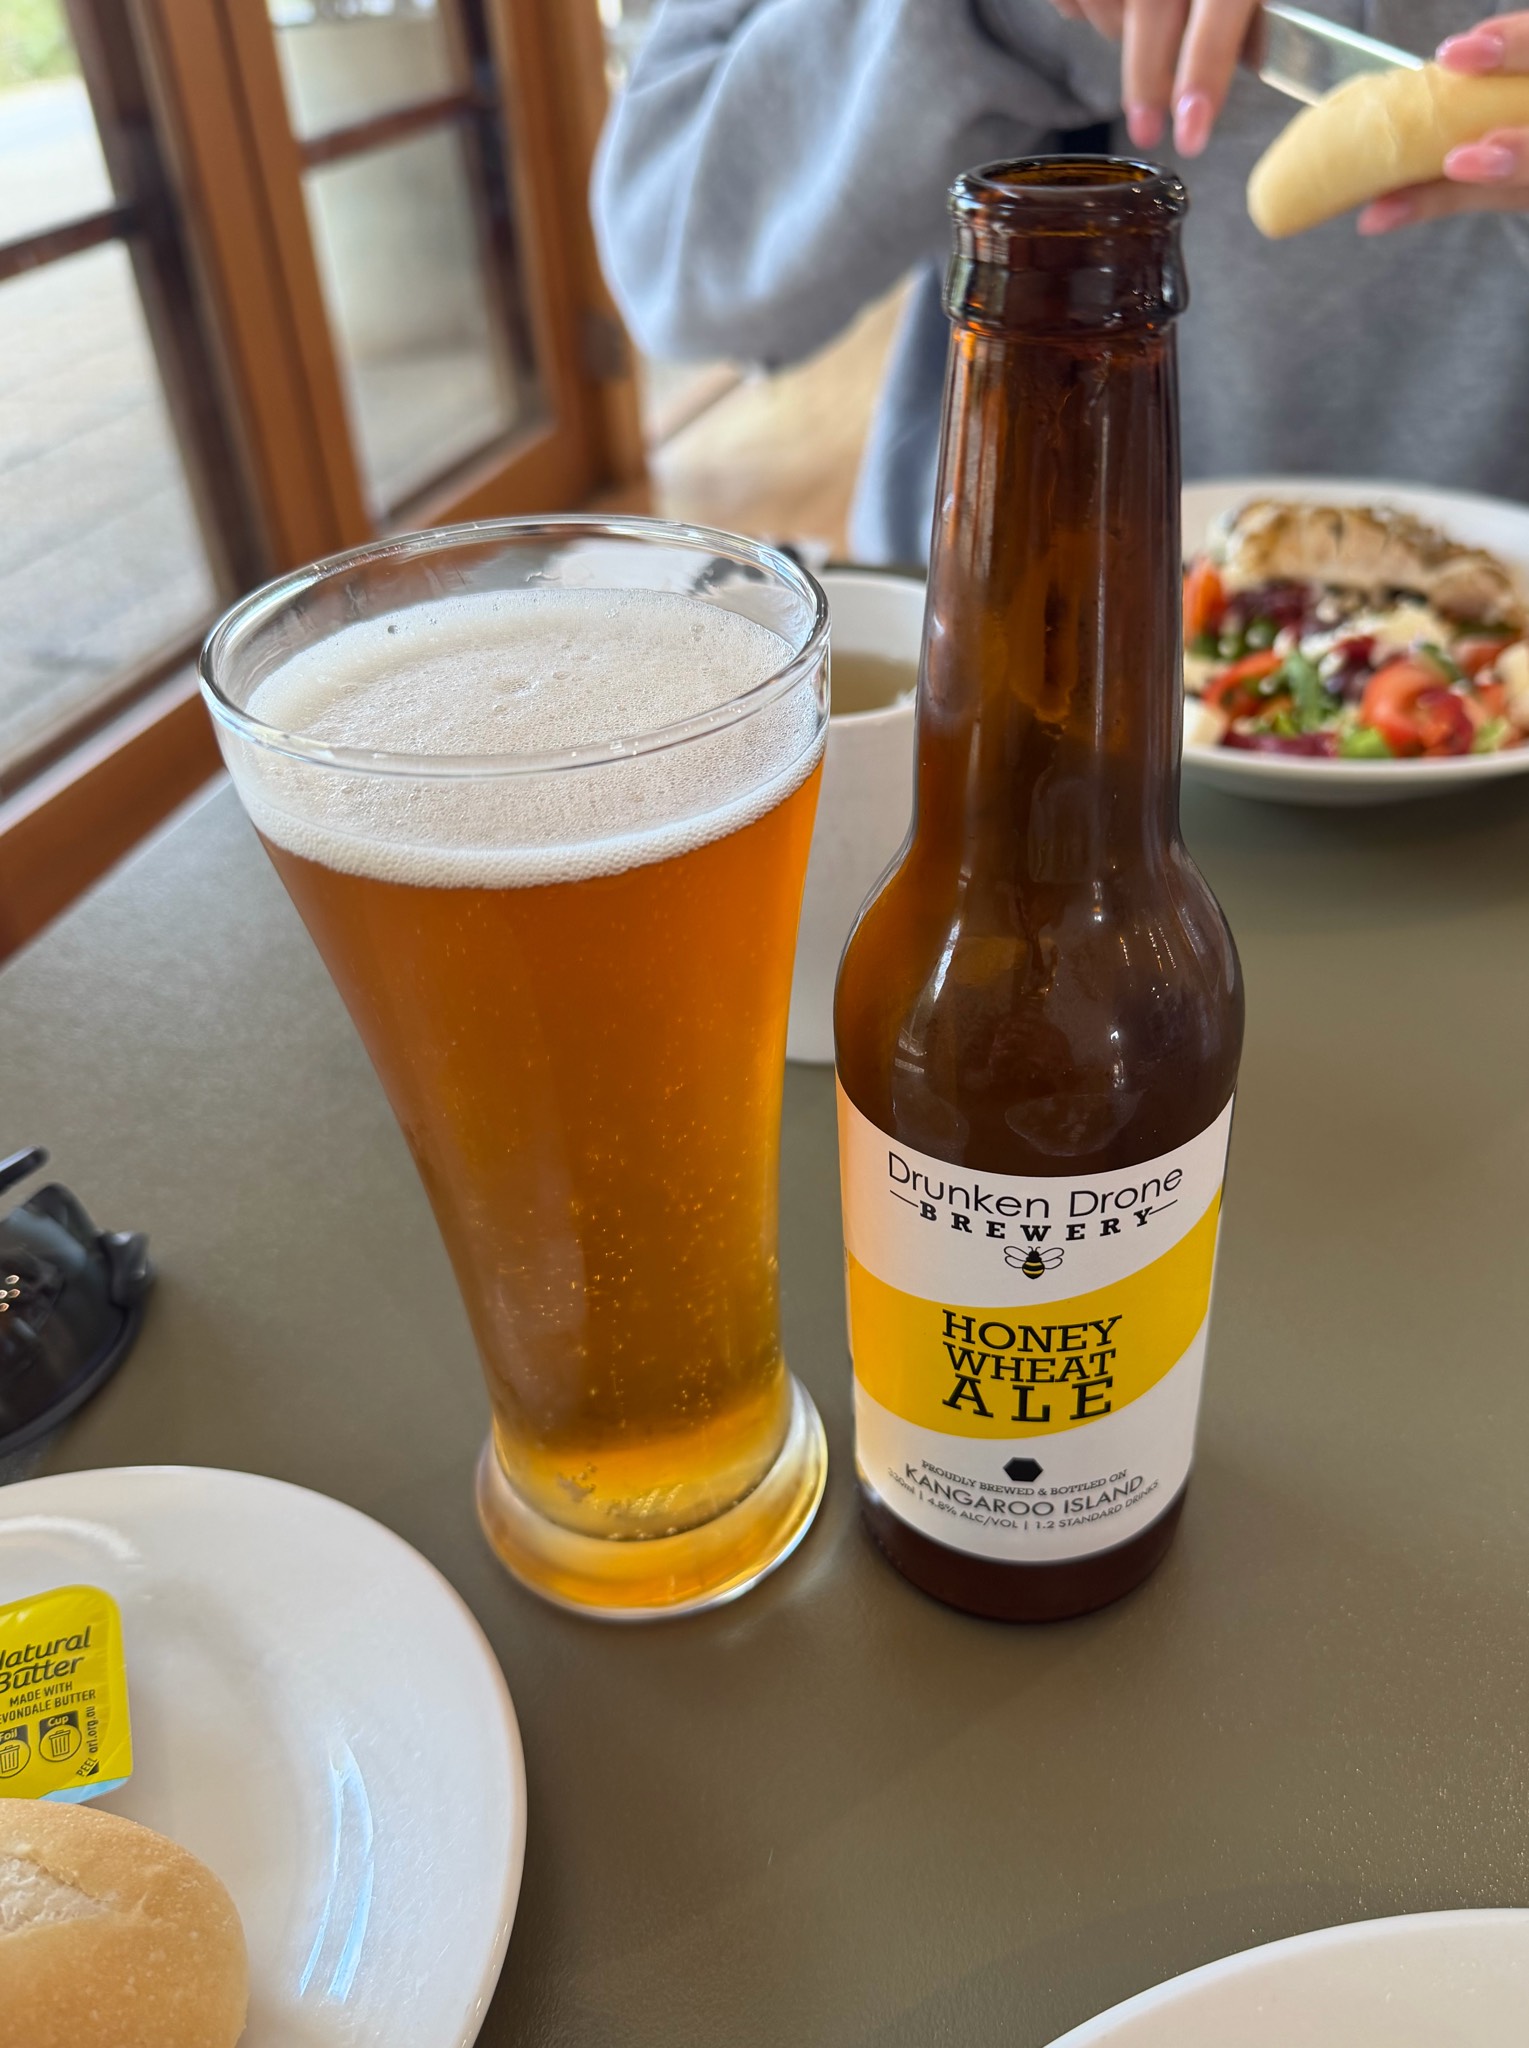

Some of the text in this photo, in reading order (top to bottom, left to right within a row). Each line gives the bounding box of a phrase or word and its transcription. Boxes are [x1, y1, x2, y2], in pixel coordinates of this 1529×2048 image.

[889, 1151, 1183, 1218] Drunken Drone
[919, 1201, 1152, 1241] BREWERY
[942, 1309, 1122, 1353] HONEY
[942, 1341, 1117, 1383] WHEAT
[942, 1373, 1113, 1422] ALE
[906, 1463, 1143, 1516] KANGAROO ISLAND
[921, 1460, 1128, 1496] PROUDLY BREWED & BOTTLED ON
[928, 1498, 957, 1516] 4.8%
[960, 1511, 1018, 1528] ALC/VOL
[1036, 1521, 1054, 1529] 1.2
[1058, 1504, 1122, 1527] STANDARD
[1125, 1479, 1159, 1508] DRINKS
[0, 1656, 85, 1694] Butter
[10, 1681, 73, 1707] MADE WITH
[54, 1689, 96, 1708] BUTTER
[0, 1728, 18, 1740] Foil
[47, 1715, 69, 1728] Cup
[76, 1757, 97, 1777] PEEL
